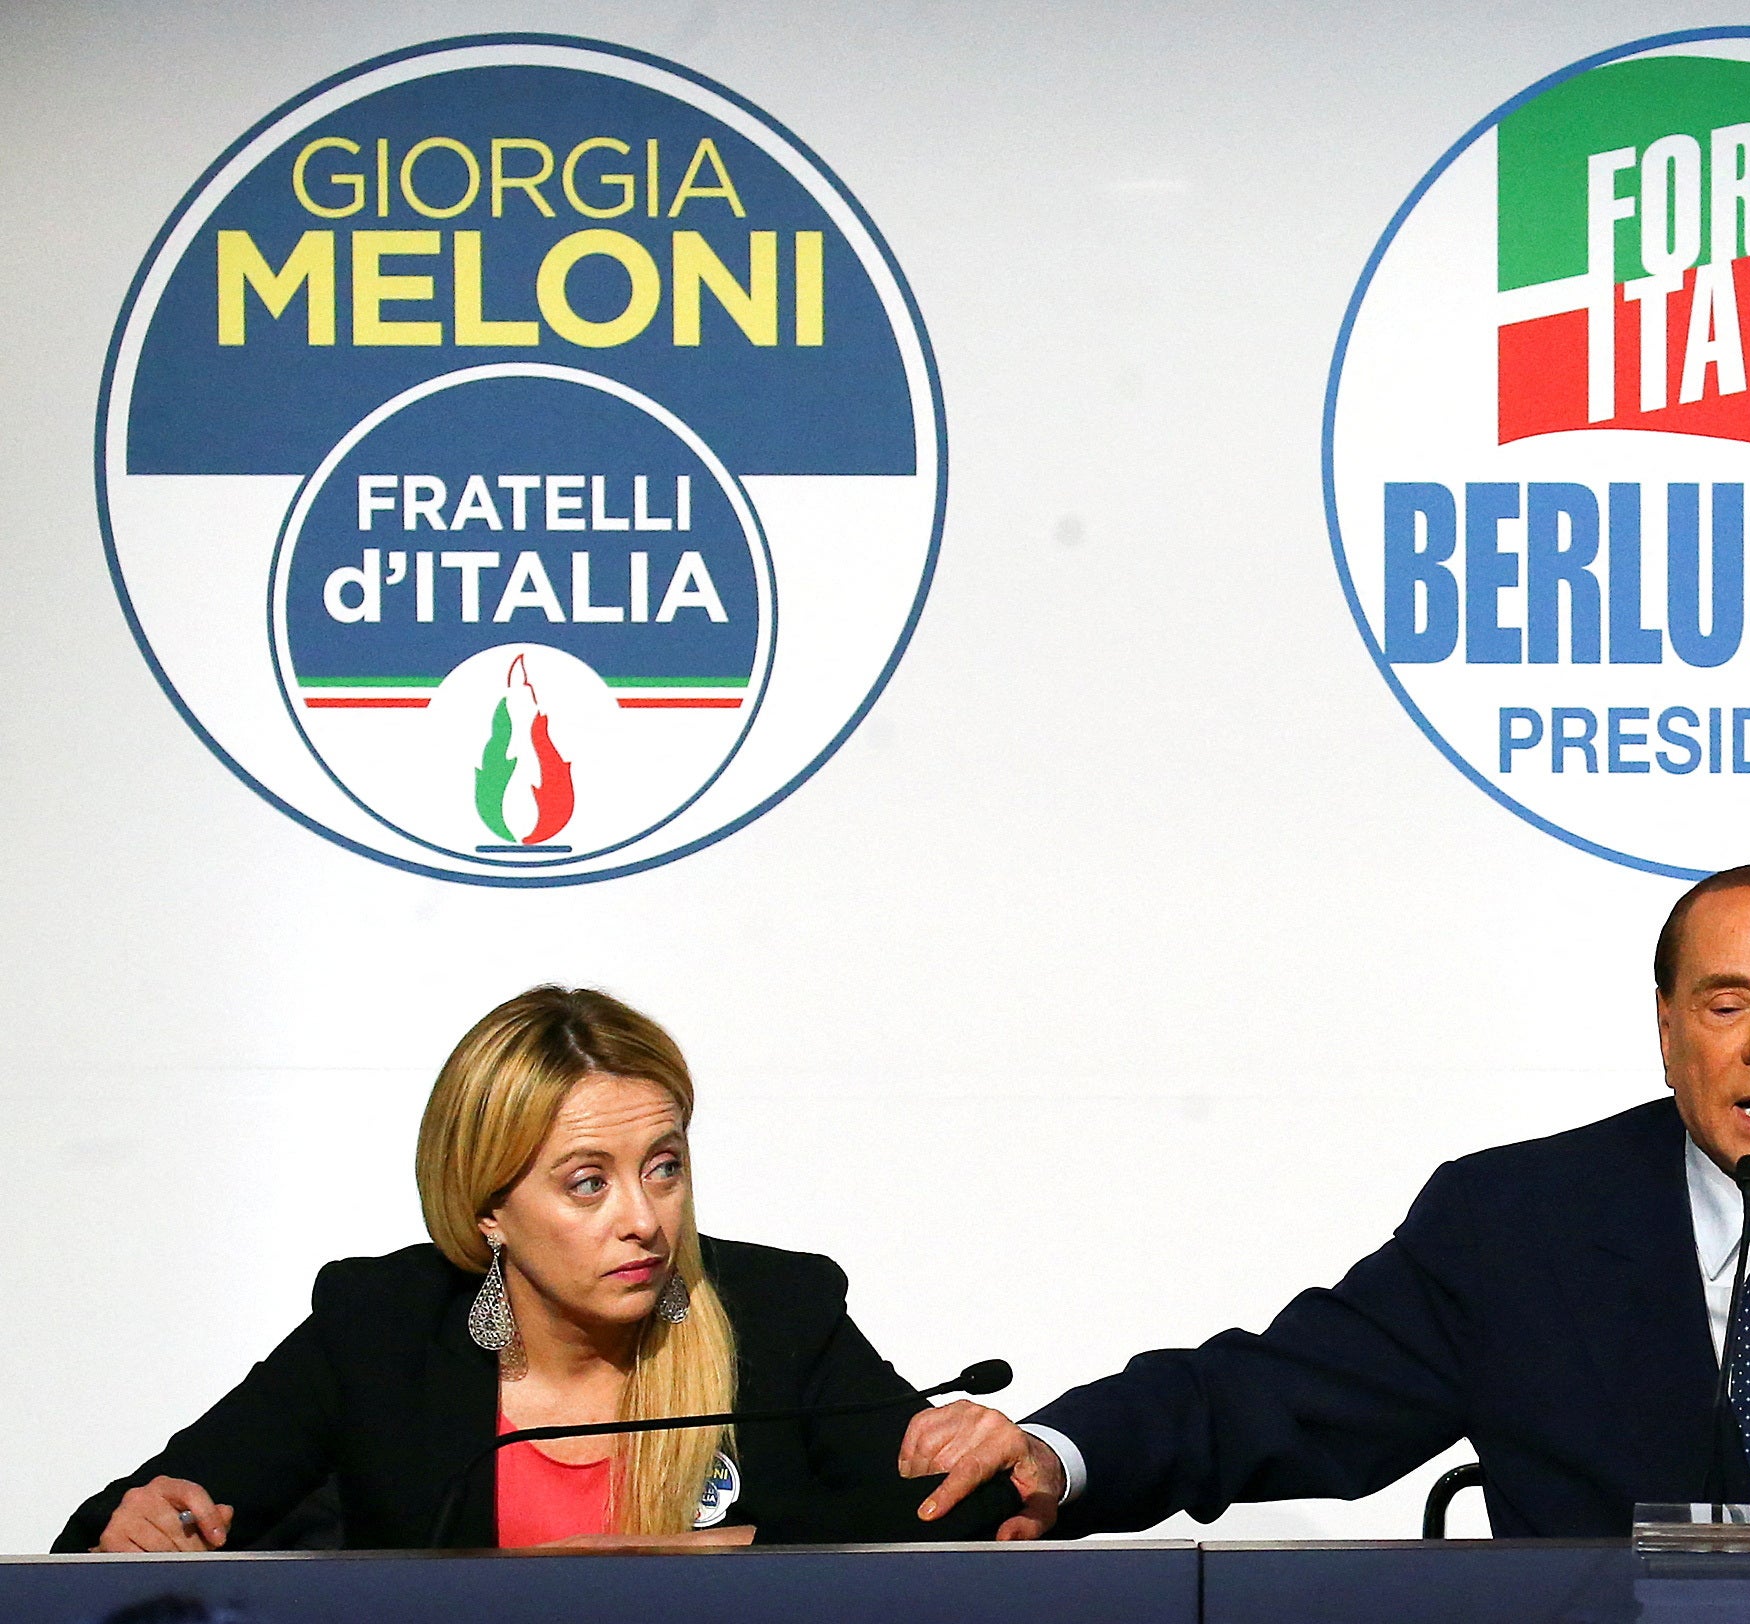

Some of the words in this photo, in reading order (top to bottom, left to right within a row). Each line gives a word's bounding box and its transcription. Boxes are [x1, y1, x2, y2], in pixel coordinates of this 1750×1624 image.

[292, 137, 746, 219] GIORGIA
[217, 229, 823, 348] MELONI
[357, 475, 691, 531] FRATELLI
